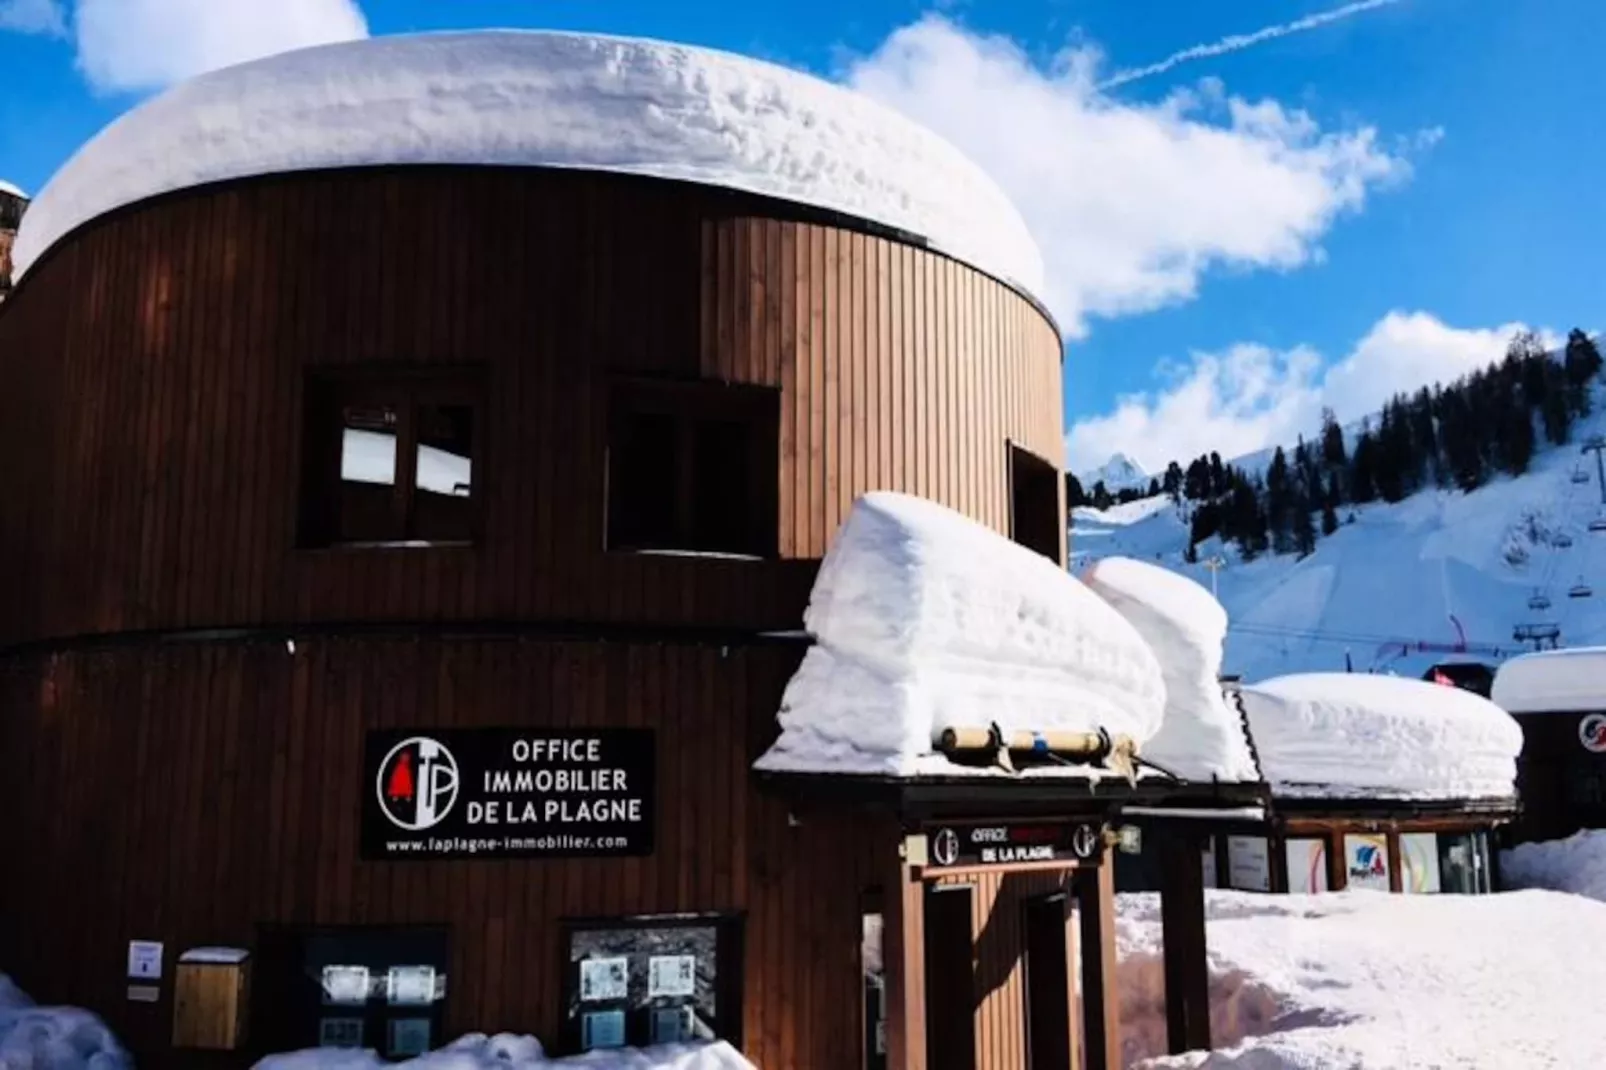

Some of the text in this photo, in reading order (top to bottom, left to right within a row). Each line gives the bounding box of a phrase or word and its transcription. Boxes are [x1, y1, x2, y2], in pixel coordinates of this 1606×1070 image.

[512, 739, 602, 762] OFFICE
[484, 768, 628, 793] IMMOBILIER
[466, 798, 643, 825] DE LA PLAGNE
[386, 834, 629, 854] www.laplagne-immobilier.com
[971, 826, 1009, 843] OFFICE
[981, 848, 997, 862] DE
[998, 847, 1015, 861] LA
